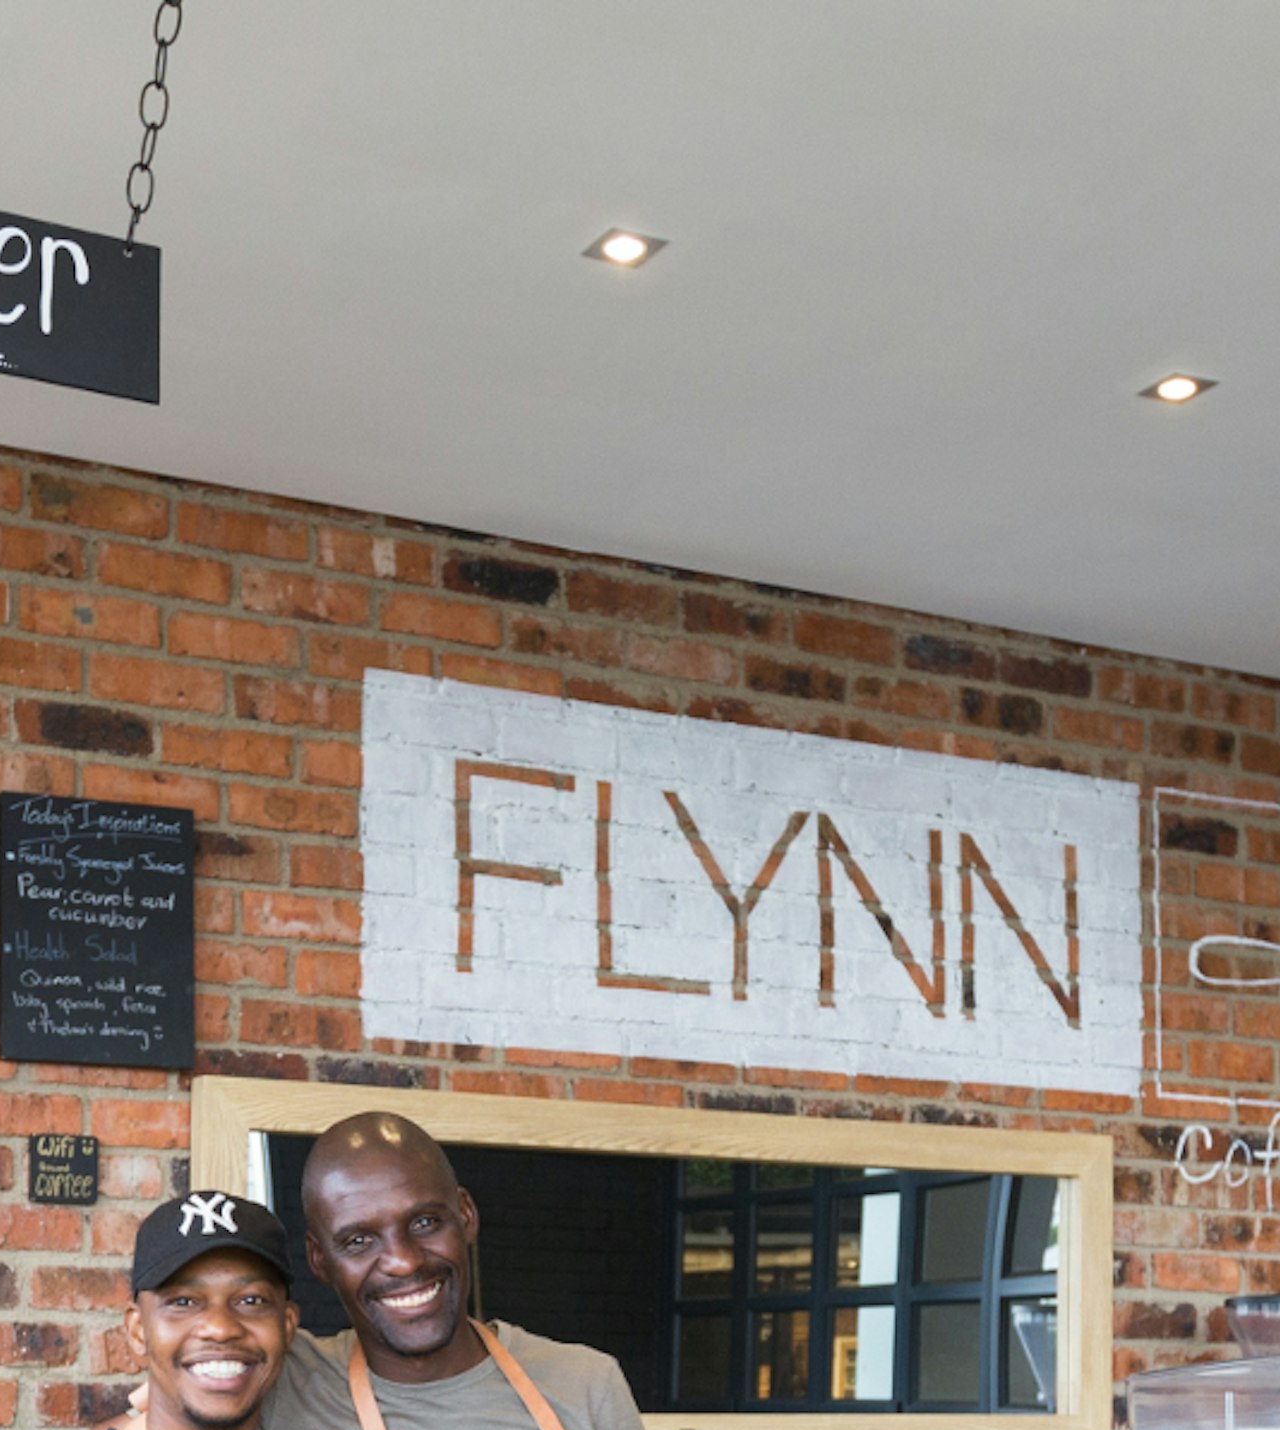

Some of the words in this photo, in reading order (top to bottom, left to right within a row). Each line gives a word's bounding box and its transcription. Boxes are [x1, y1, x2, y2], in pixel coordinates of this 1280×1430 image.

[140, 892, 176, 911] and
[453, 758, 1083, 1029] FLYNN
[48, 906, 148, 930] cucumber
[178, 1192, 239, 1237] NY
